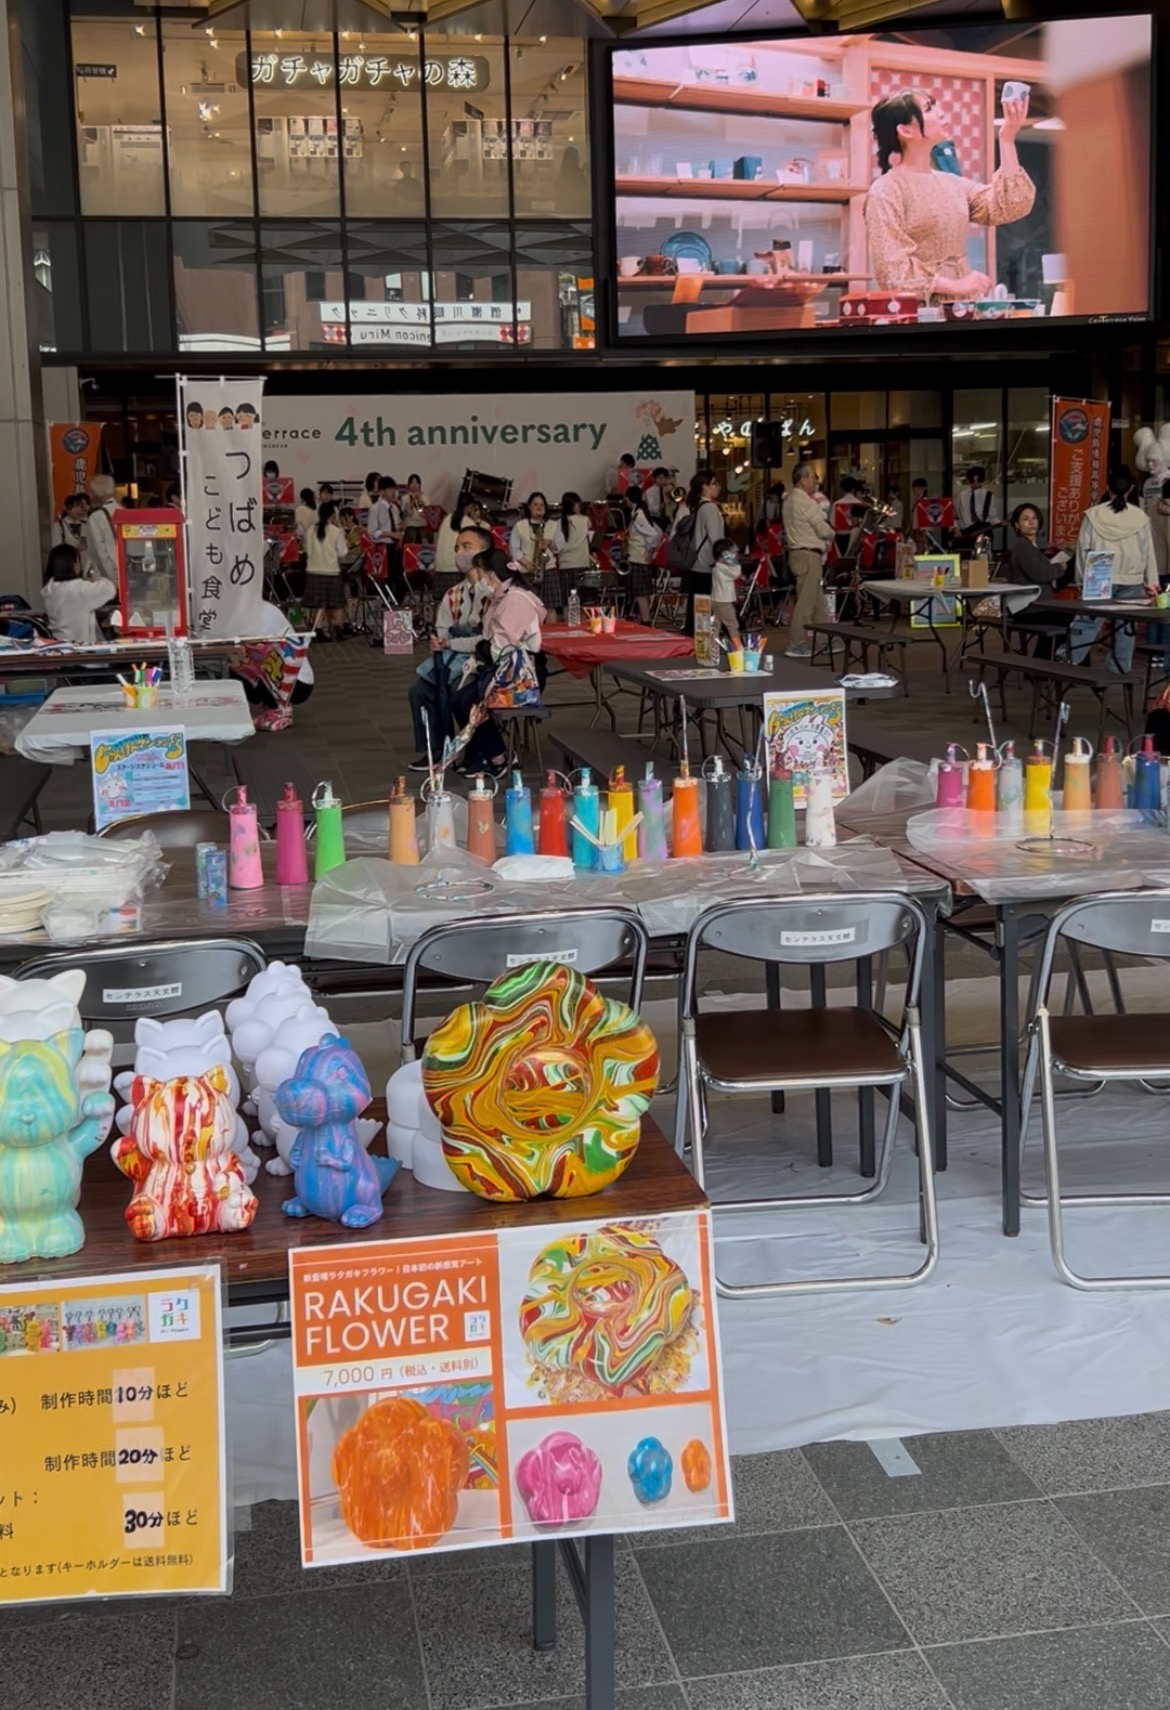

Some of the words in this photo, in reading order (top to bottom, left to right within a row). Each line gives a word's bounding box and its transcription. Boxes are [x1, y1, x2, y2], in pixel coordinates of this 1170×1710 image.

[251, 53, 478, 88] ガチャガチャの森
[261, 428, 322, 440] errace
[334, 415, 396, 447] 4th
[406, 415, 607, 451] anniversary
[225, 451, 258, 586] つばめ
[198, 475, 223, 632] こども食堂
[304, 1275, 487, 1321] RAKUGAKI
[305, 1313, 449, 1356] FLOWER
[323, 1366, 375, 1388] 7,000
[40, 1381, 188, 1410] 制作時間10分ほど
[44, 1445, 191, 1472] 制作時間20分ほど
[124, 1509, 198, 1533] 30分ほど
[0, 1553, 193, 1578] となります(キーホルダーは送料無料)
